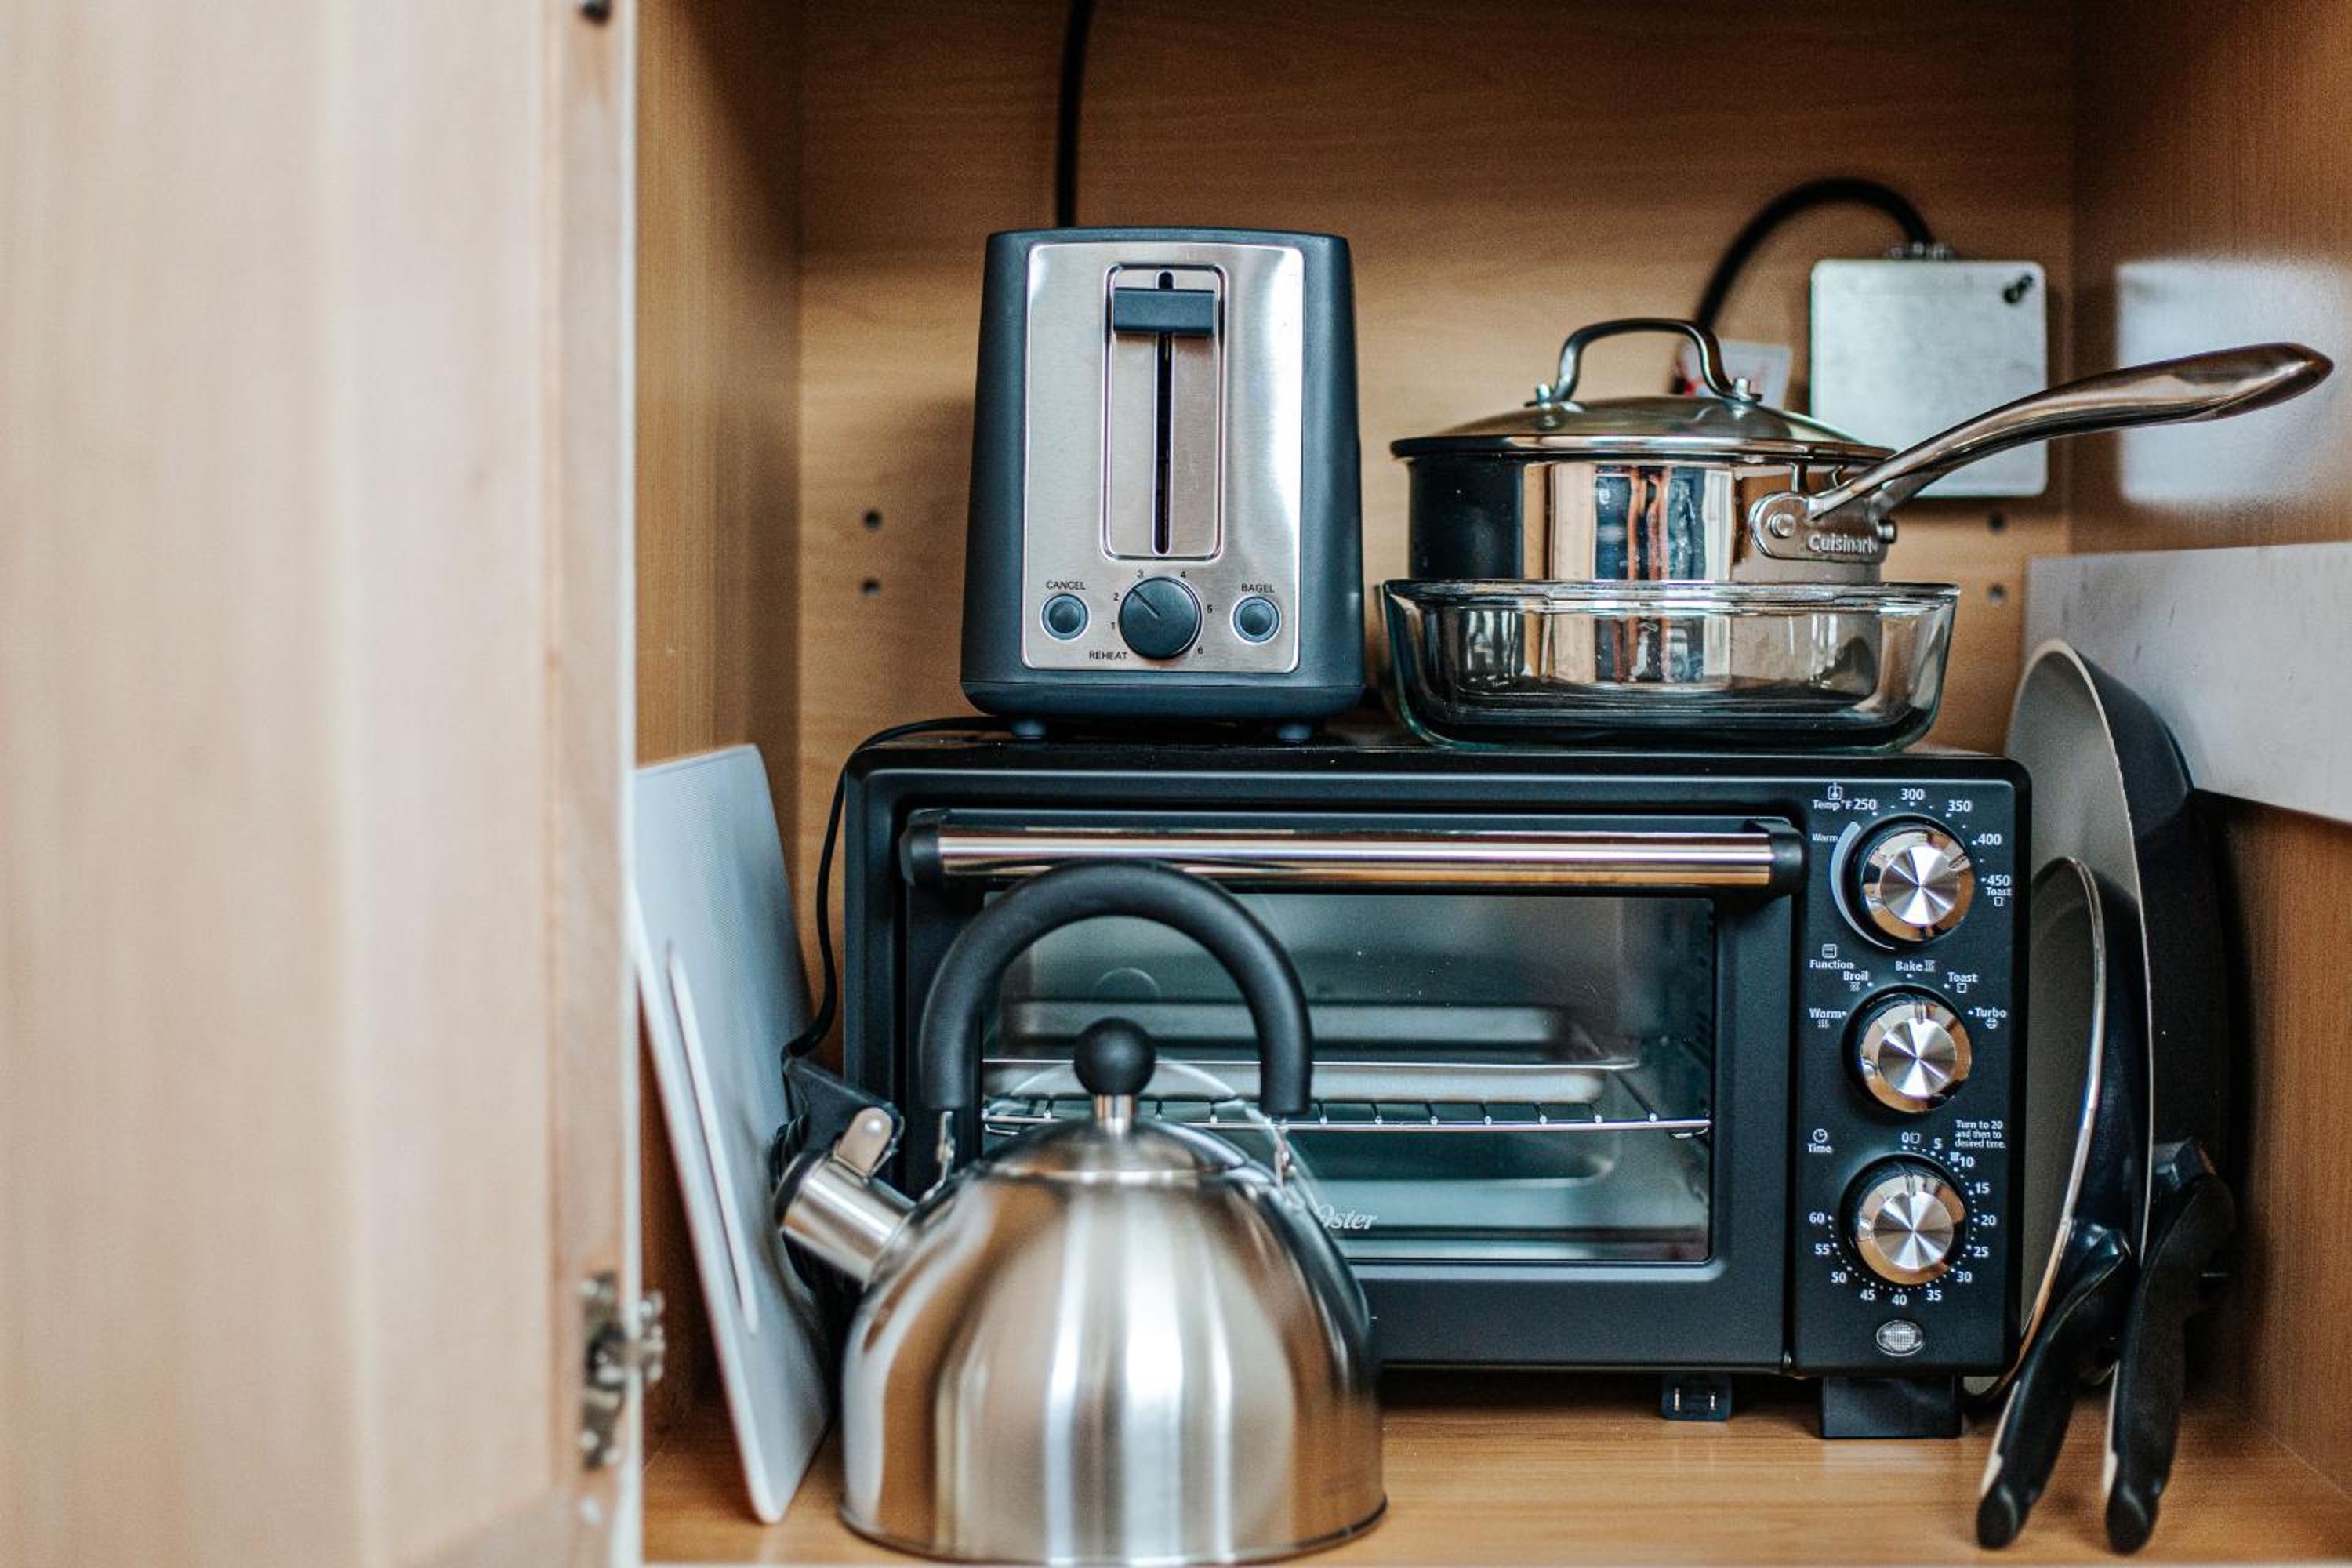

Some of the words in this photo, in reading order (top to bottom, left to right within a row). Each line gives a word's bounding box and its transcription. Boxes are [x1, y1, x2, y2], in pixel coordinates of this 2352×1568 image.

[1137, 569, 1144, 579] 3
[1180, 570, 1186, 579] 4
[1046, 580, 1086, 590] CANCEL
[1241, 583, 1275, 593] BAGEL
[1113, 593, 1119, 601] 2
[1207, 604, 1213, 614] 5
[1089, 651, 1127, 660] REHEAT
[1197, 646, 1203, 655] 6
[1901, 788, 1924, 800] 300
[1853, 798, 1877, 811] 250
[1947, 800, 1972, 812] 350
[1812, 833, 1838, 843] Warm
[1978, 833, 2002, 845] 400
[1986, 874, 2011, 887] 450
[1987, 887, 2012, 896] Toast
[1809, 960, 1853, 970] Function
[1896, 960, 1923, 971] Bake
[1843, 970, 1868, 981] Broil
[1948, 971, 1978, 982] Toast
[1809, 1008, 1842, 1018] Warm
[1975, 1007, 2006, 1018] Turbo
[1955, 1120, 1976, 1129] Turn
[1979, 1120, 1989, 1129] to
[1991, 1120, 2003, 1129] 20
[1808, 1144, 1832, 1153] Time
[1933, 1139, 1942, 1149] 5
[1959, 1156, 1974, 1167] 10
[1976, 1183, 1990, 1194] 15
[1809, 1213, 1824, 1224] 60
[1981, 1214, 1996, 1226] 20
[1815, 1244, 1830, 1255] 55
[1973, 1247, 1989, 1258] 25
[1831, 1272, 1846, 1283] 50
[1957, 1272, 1973, 1283] 30
[1860, 1290, 1875, 1301] 45
[1892, 1294, 1907, 1306] 40
[1926, 1290, 1942, 1301] 35
